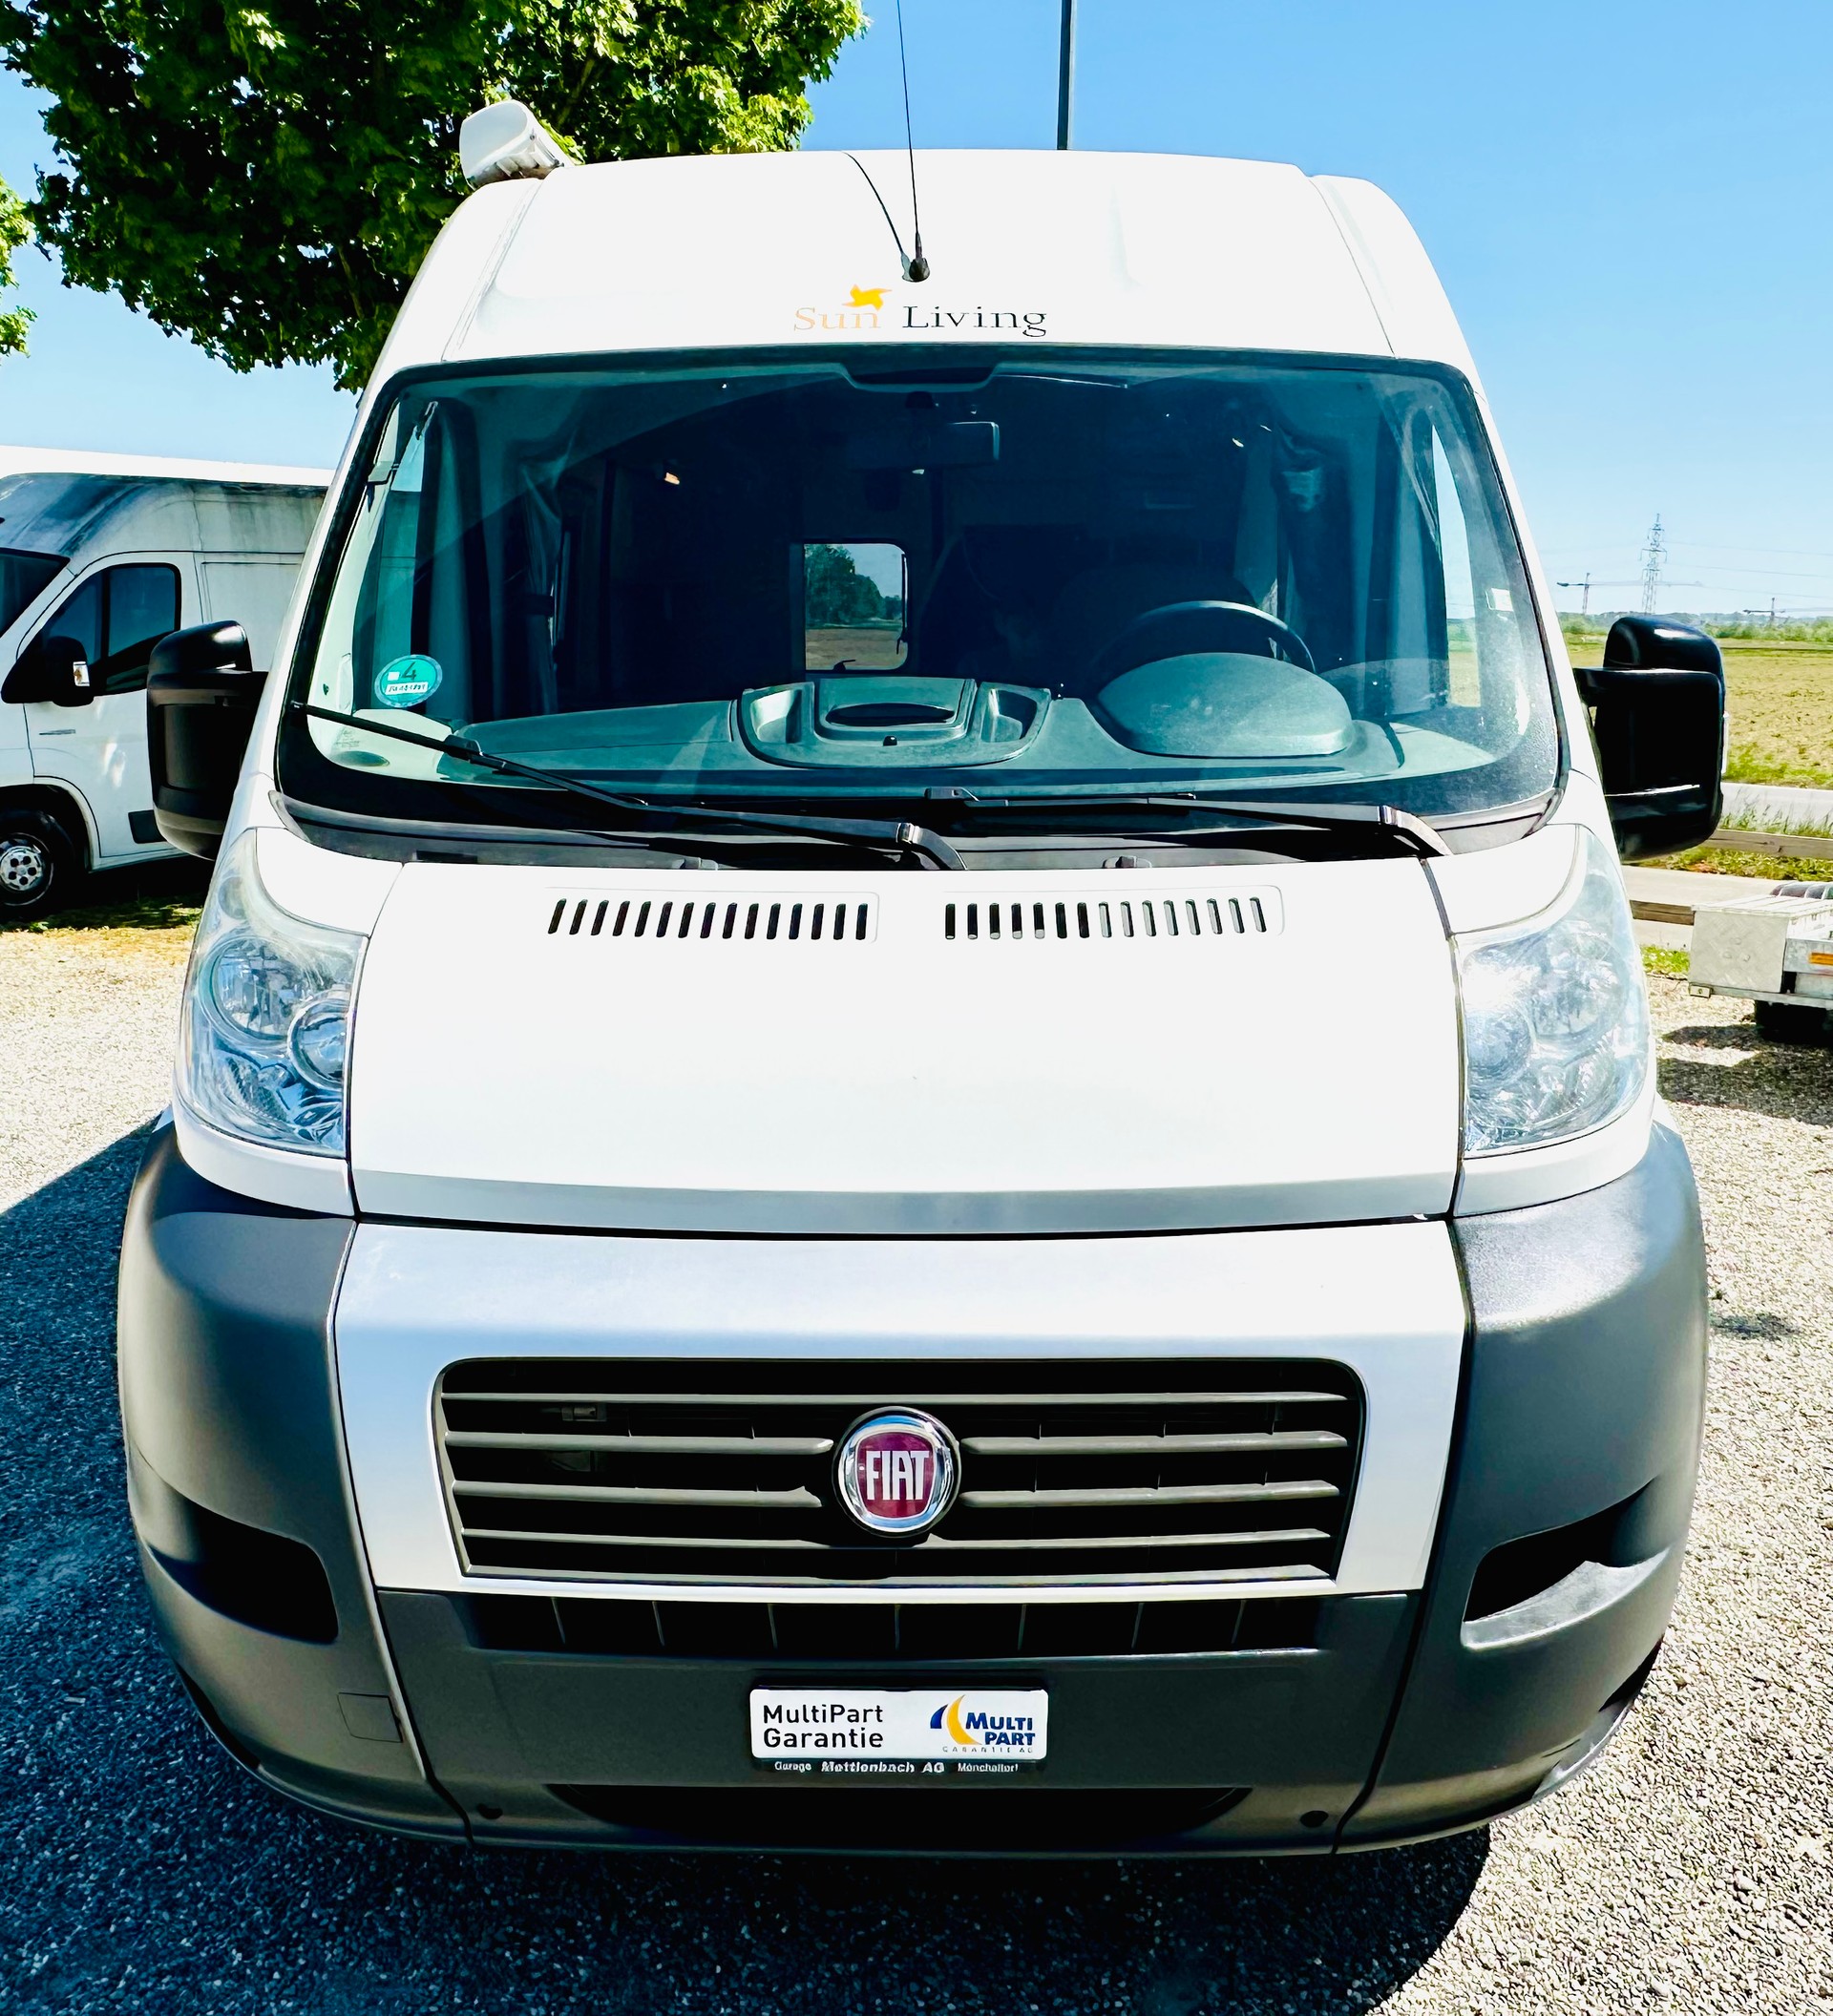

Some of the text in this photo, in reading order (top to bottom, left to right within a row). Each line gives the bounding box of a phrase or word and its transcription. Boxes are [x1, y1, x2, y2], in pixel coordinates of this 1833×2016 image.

[793, 305, 1047, 338] Sun Living
[401, 661, 417, 682] 4
[866, 1450, 930, 1501] FIAT
[763, 1704, 884, 1724] MultiPart
[965, 1712, 1033, 1731] MULTI
[763, 1728, 884, 1749] Garantie
[984, 1732, 1036, 1746] PART
[921, 1761, 945, 1774] AG
